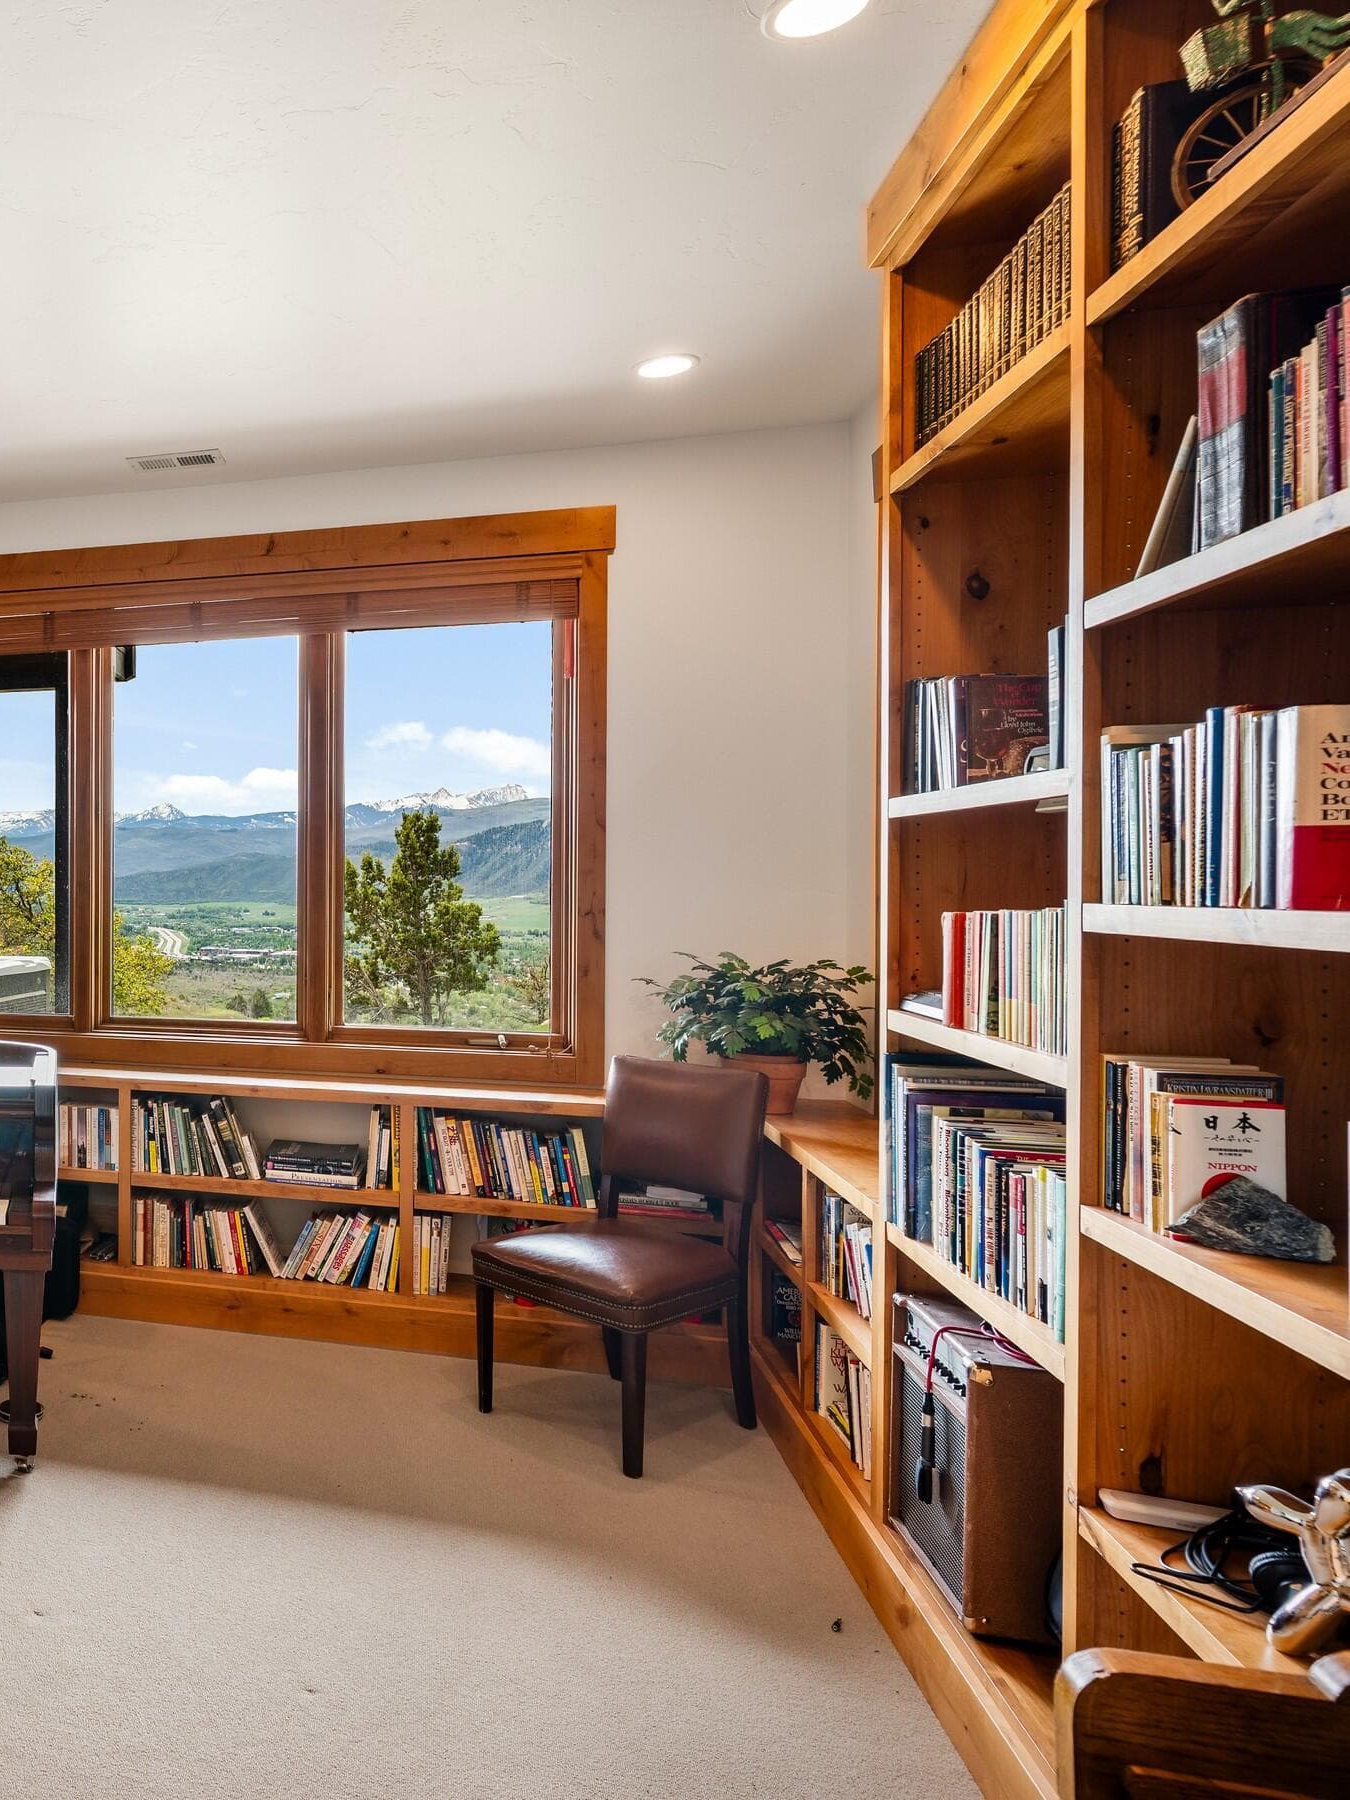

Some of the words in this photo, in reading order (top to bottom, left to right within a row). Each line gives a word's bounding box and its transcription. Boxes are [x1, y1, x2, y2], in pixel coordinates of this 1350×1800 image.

[1166, 1083, 1201, 1094] KRISTIN
[1203, 1112, 1261, 1134] 日本
[1207, 1162, 1258, 1172] NIPPON
[943, 1189, 951, 1238] Bloomberg
[333, 1239, 353, 1271] passages
